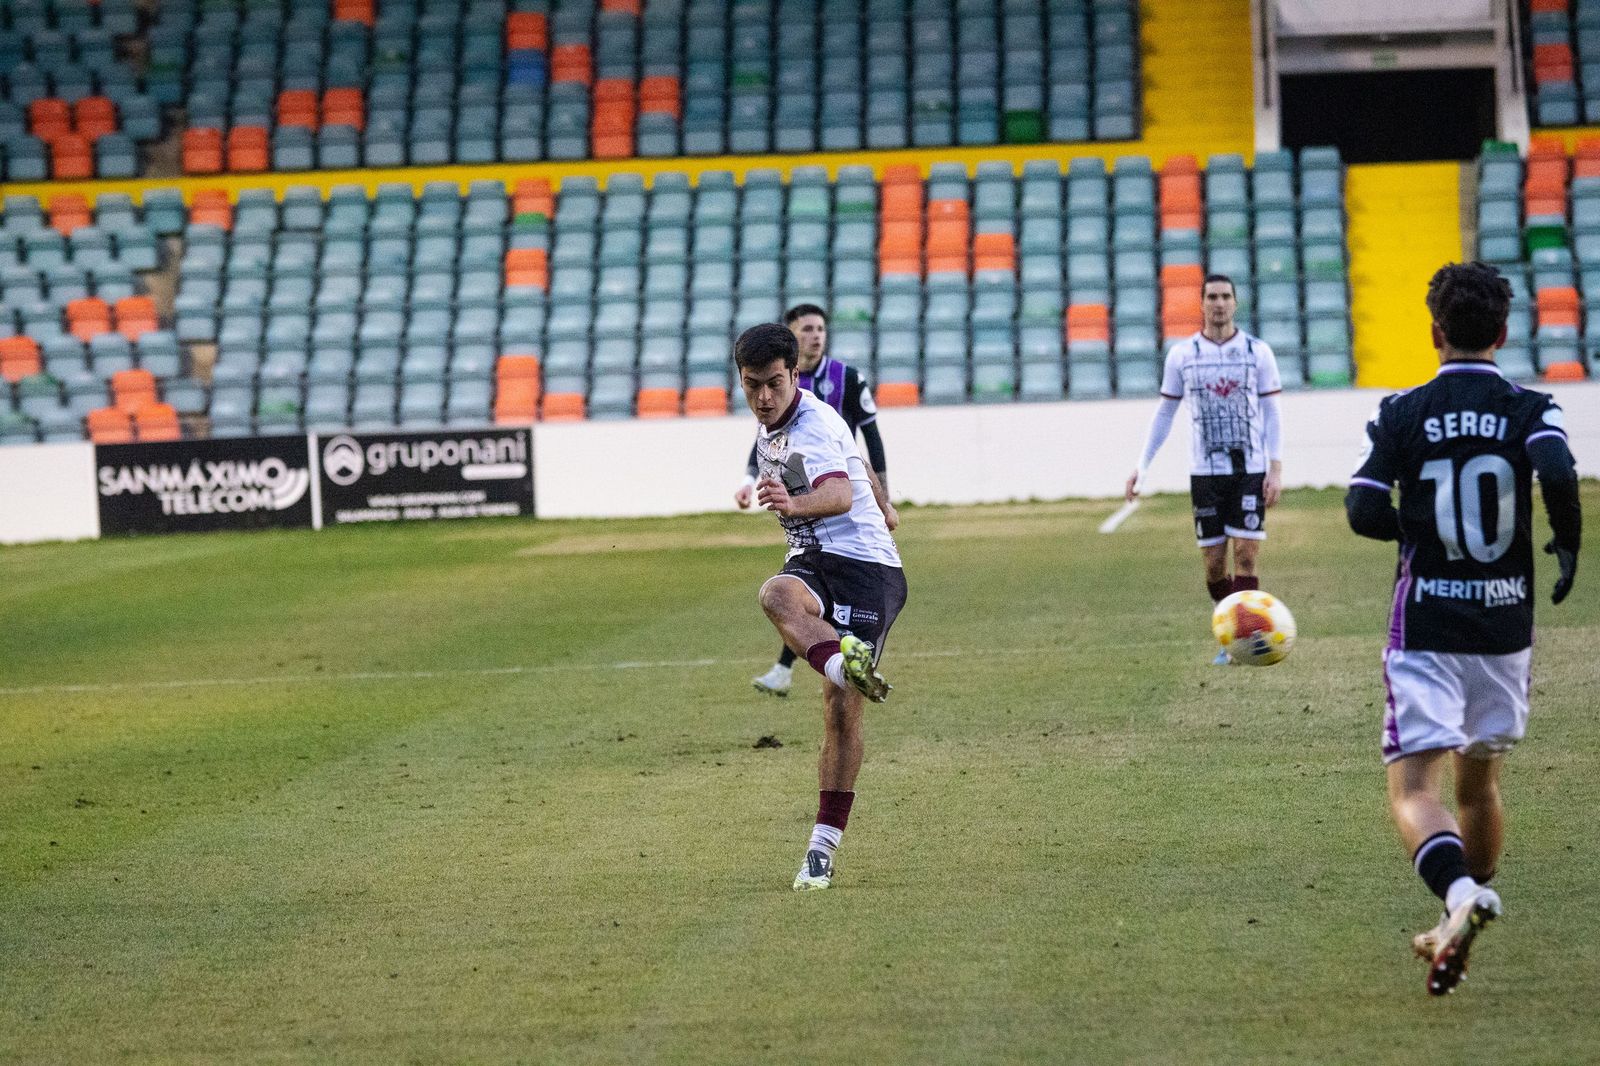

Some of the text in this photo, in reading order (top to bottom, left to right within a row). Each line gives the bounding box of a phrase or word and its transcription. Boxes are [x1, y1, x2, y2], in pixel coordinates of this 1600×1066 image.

[1423, 411, 1509, 443] SERGI
[366, 431, 527, 476] gruponani
[158, 489, 276, 515] TELECOM
[1419, 454, 1516, 563] 10
